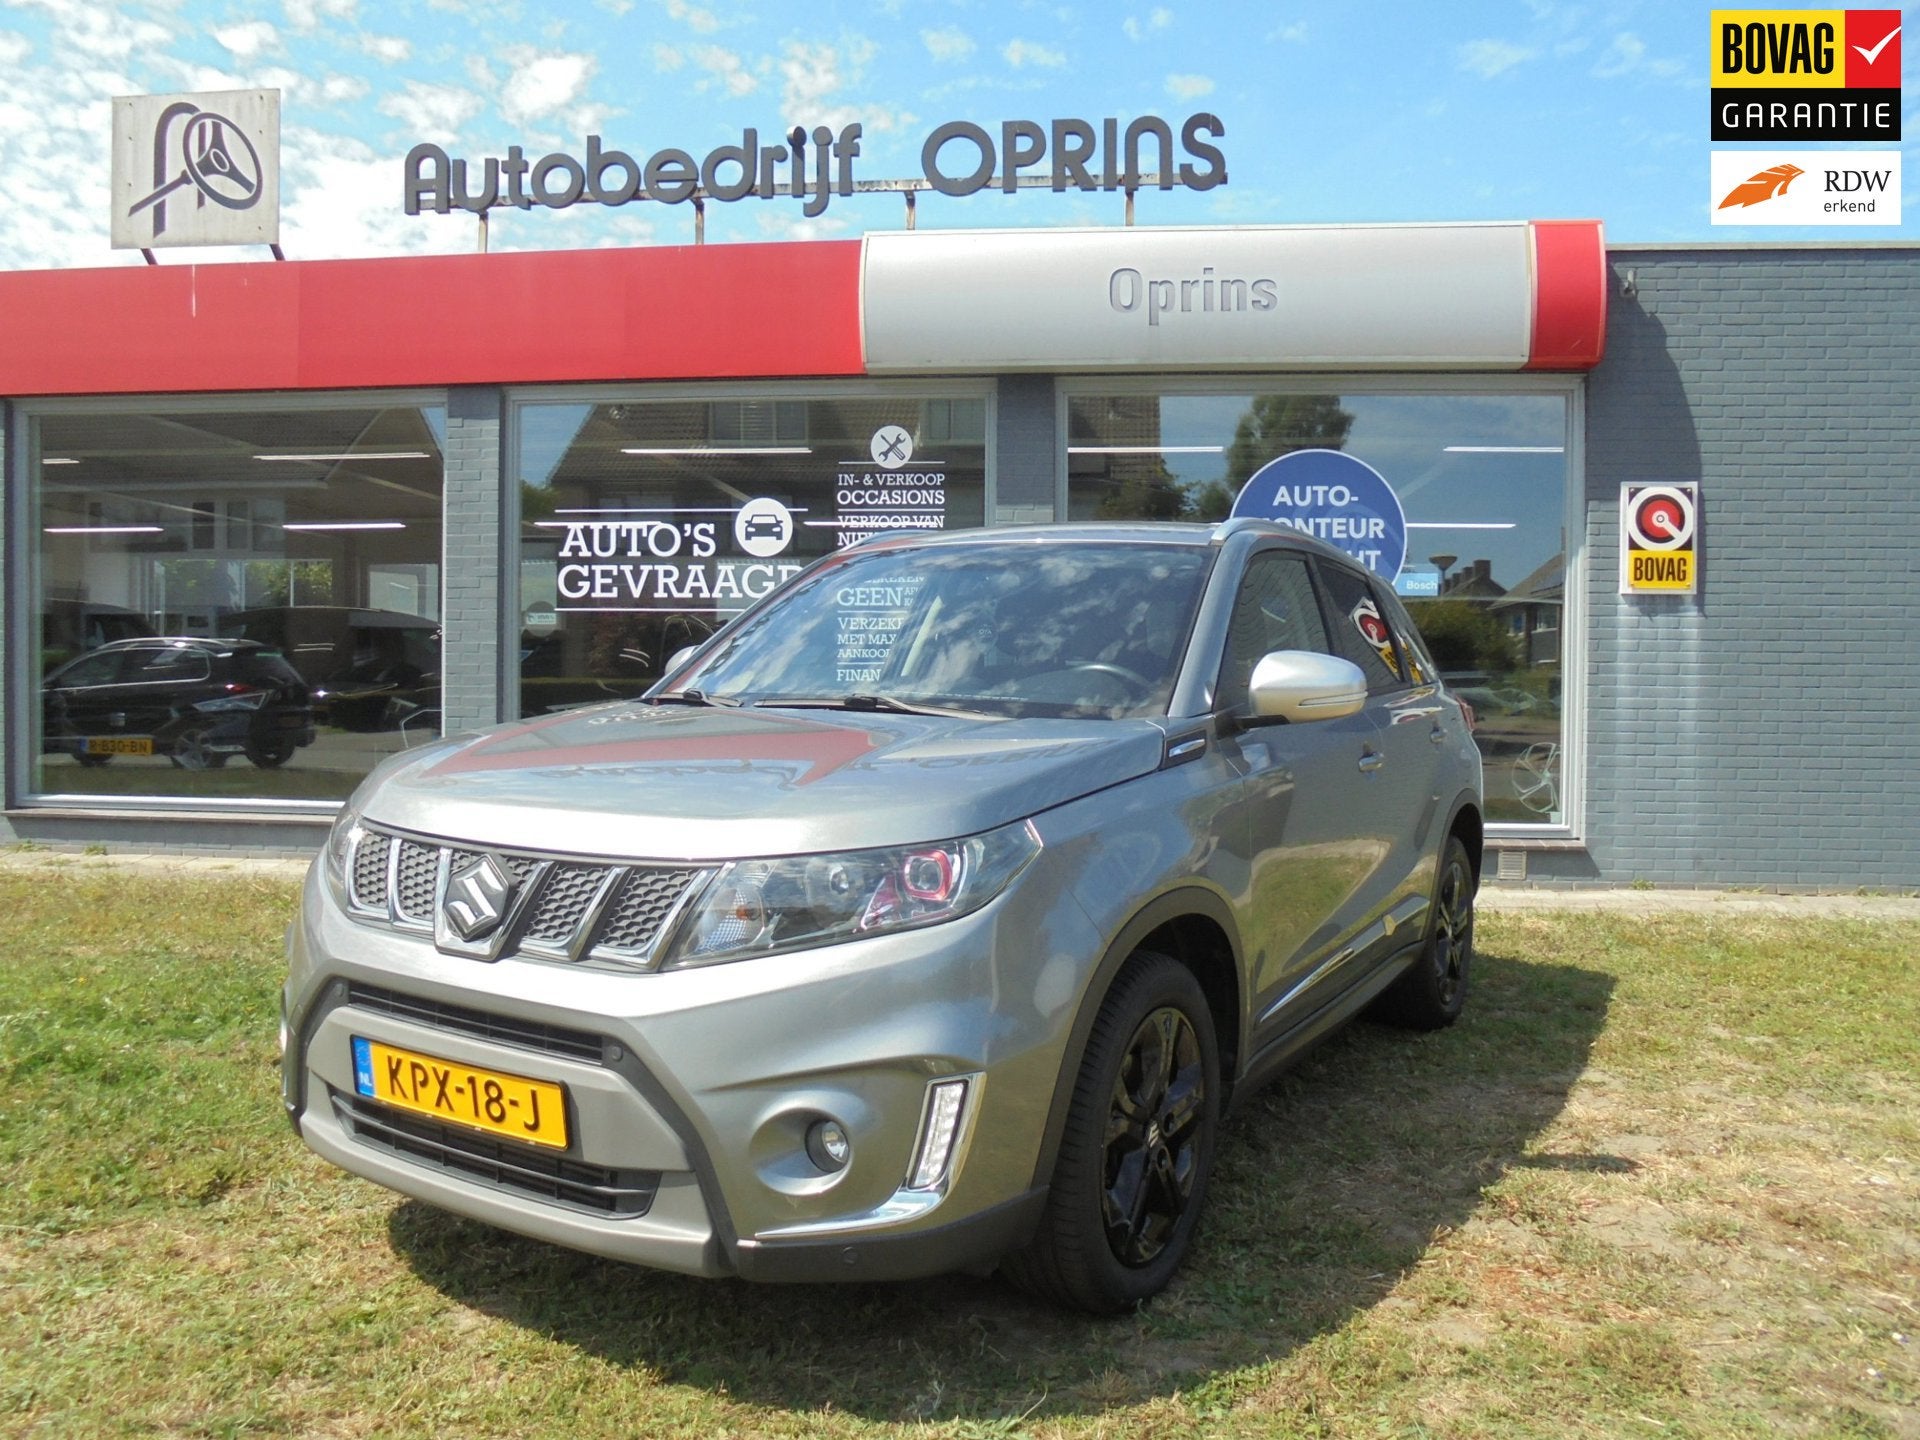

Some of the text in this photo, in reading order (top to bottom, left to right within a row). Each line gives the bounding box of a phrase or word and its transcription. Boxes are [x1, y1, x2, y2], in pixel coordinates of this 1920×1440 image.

[404, 112, 1226, 218] Autobedrijf OPRINS
[1109, 266, 1278, 326] Oprins
[838, 473, 945, 486] IN- & VERKOOP
[837, 489, 945, 505] OCCASIONS
[1272, 485, 1359, 507] AUTO-
[838, 515, 945, 528] VERKOOP VAN
[1262, 517, 1385, 540] NTEUR
[558, 522, 717, 558] AUTO'S
[1633, 557, 1687, 582] BOVAG
[1407, 580, 1438, 590] Bosch
[837, 587, 904, 607] GEEN
[837, 633, 866, 645] MET
[359, 1054, 540, 1132] NL KPX-18-J
